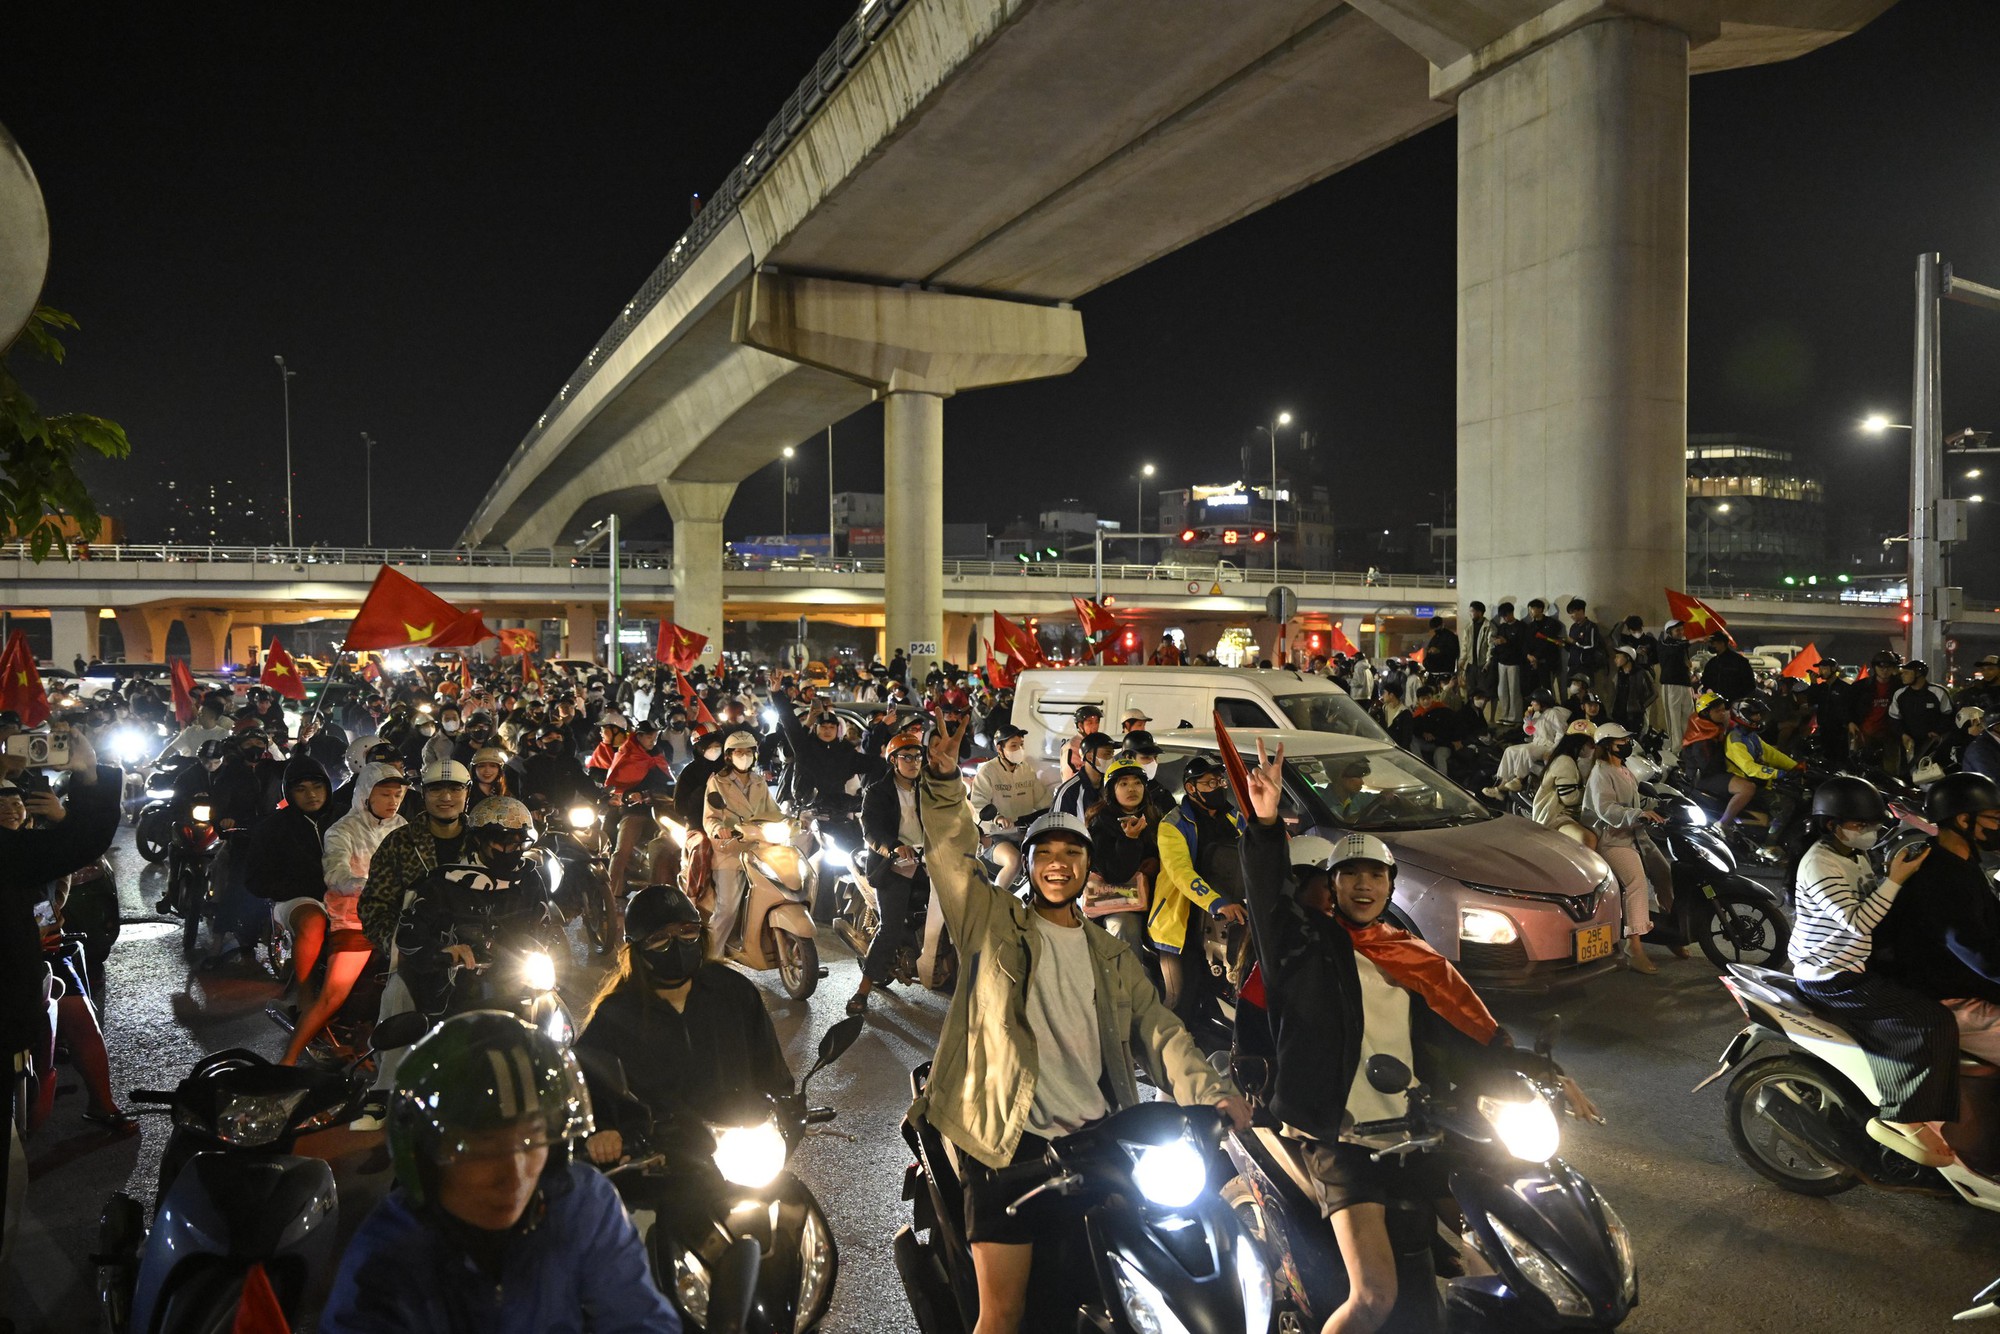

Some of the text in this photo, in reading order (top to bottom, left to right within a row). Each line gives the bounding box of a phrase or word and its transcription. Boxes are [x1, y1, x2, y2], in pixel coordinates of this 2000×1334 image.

[911, 643, 936, 654] P243
[1190, 877, 1210, 896] be
[1587, 928, 1603, 943] 29E
[1581, 941, 1609, 960] 093.48
[1778, 1010, 1834, 1038] VISION
